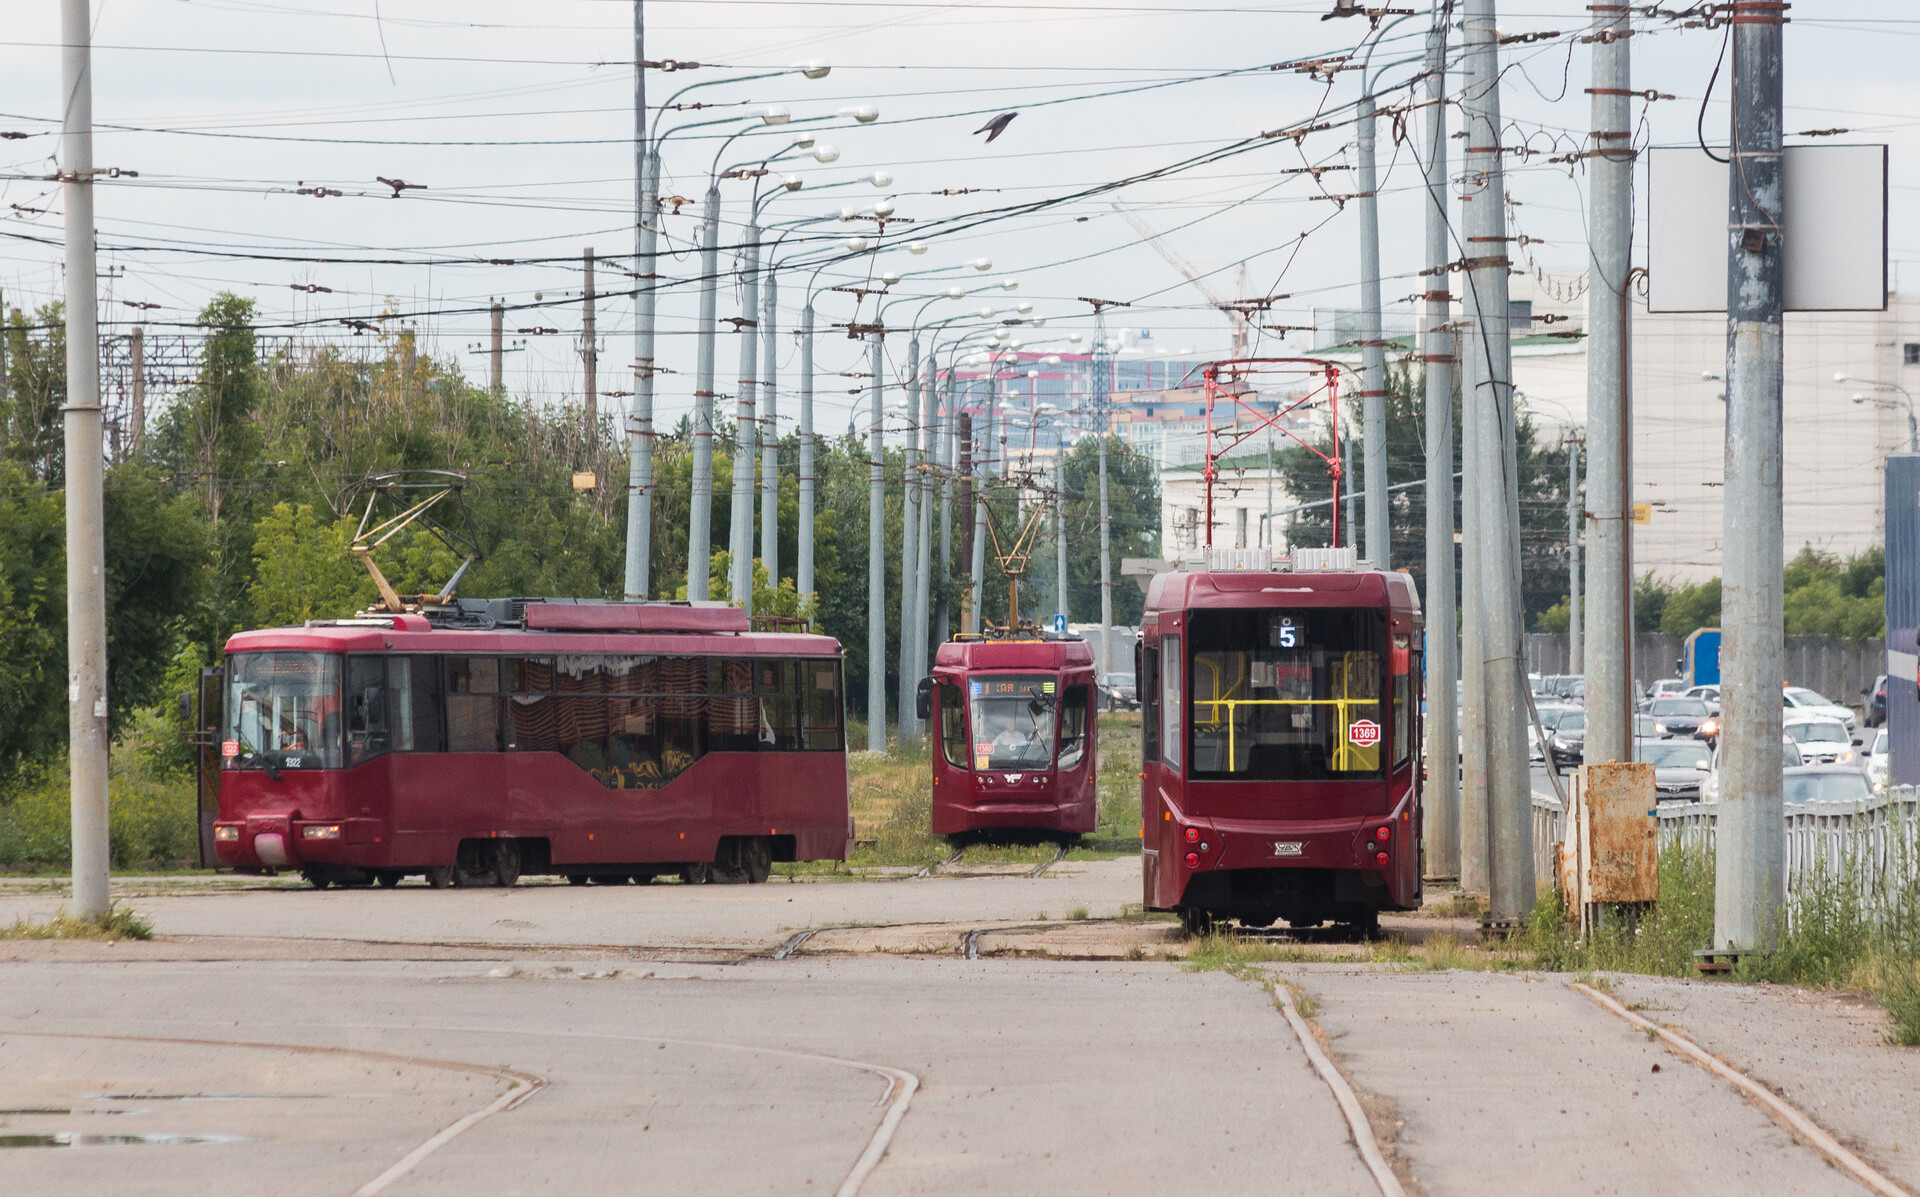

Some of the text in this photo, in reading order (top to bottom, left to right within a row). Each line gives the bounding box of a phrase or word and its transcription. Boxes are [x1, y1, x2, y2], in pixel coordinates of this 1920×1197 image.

[1280, 626, 1296, 648] 5
[1353, 728, 1376, 739] 1369
[285, 757, 301, 768] 1322
